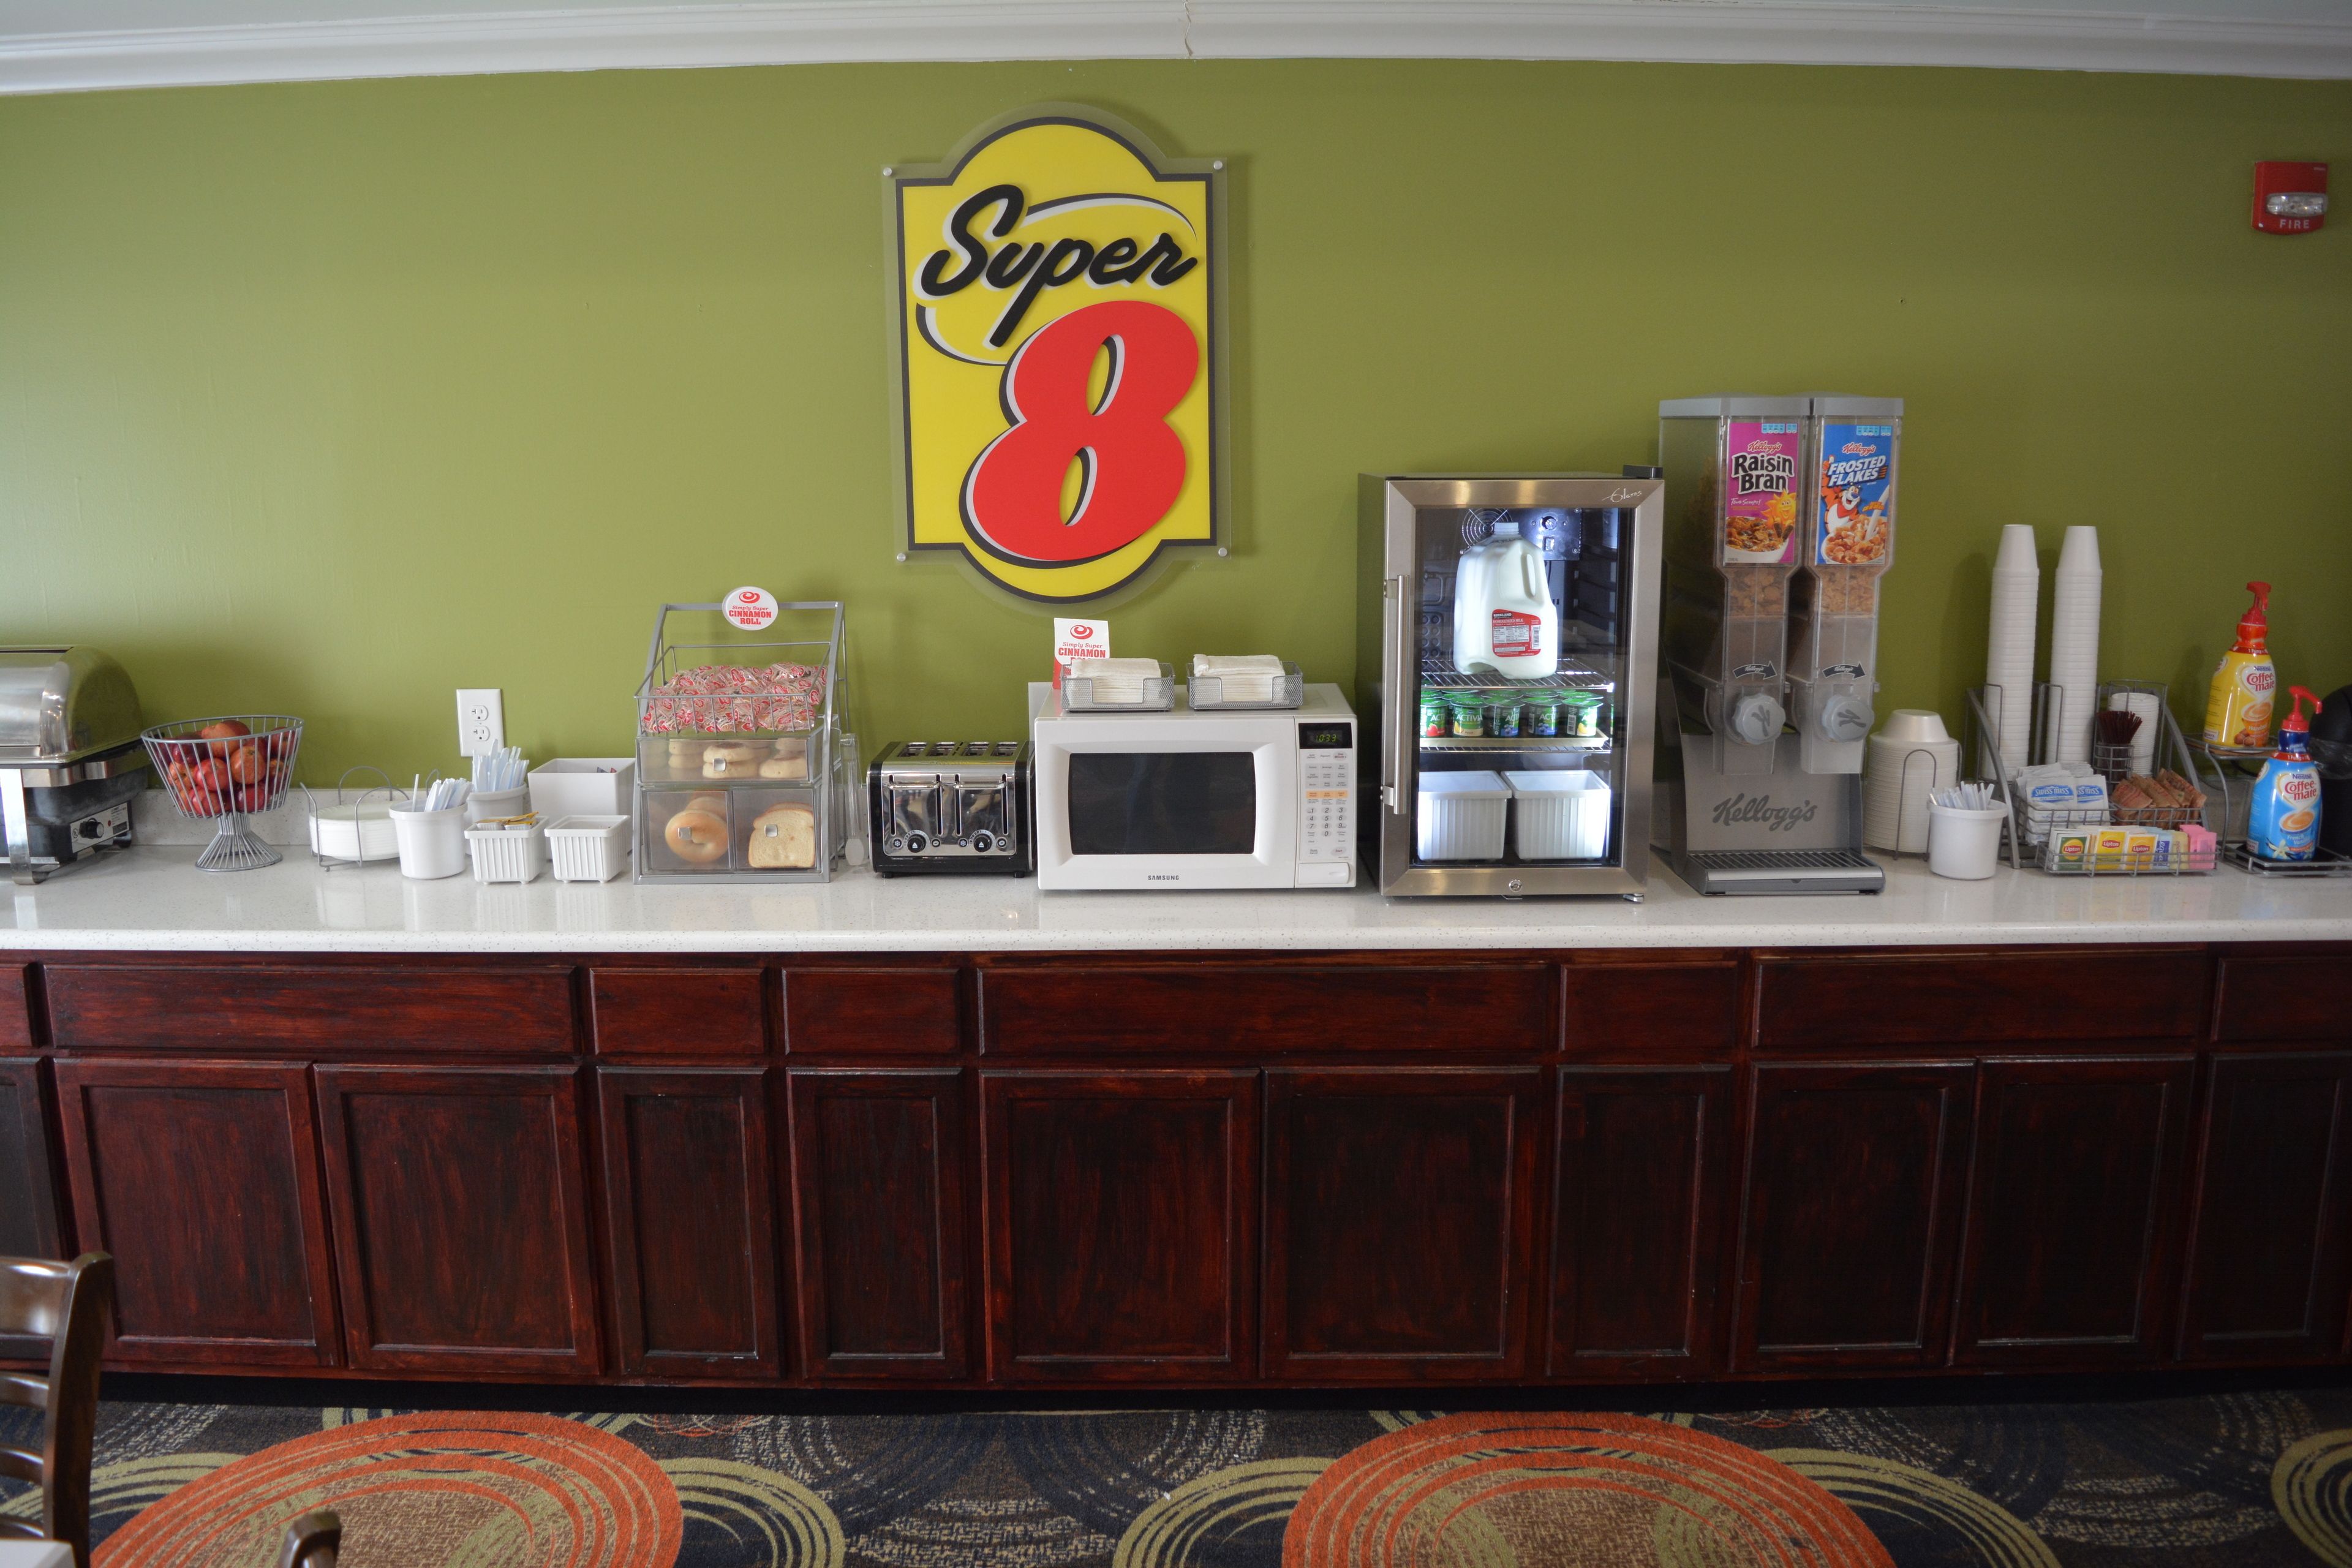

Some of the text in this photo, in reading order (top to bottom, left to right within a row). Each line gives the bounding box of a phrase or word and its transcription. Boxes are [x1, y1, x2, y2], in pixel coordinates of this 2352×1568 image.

[2280, 219, 2310, 229] FIRE
[918, 184, 1199, 349] Super
[962, 300, 1199, 565] 8
[1747, 440, 1782, 454] Kellogg's
[1842, 442, 1877, 456] Kellogg's
[1733, 453, 1794, 477] Raisin
[1828, 456, 1886, 476] FROSTED
[1739, 473, 1788, 492] Bran
[1828, 467, 1880, 487] FLAKES
[1058, 647, 1106, 658] CINNAMON
[2294, 788, 2316, 801] mate
[1713, 793, 1818, 831] Kellogg's
